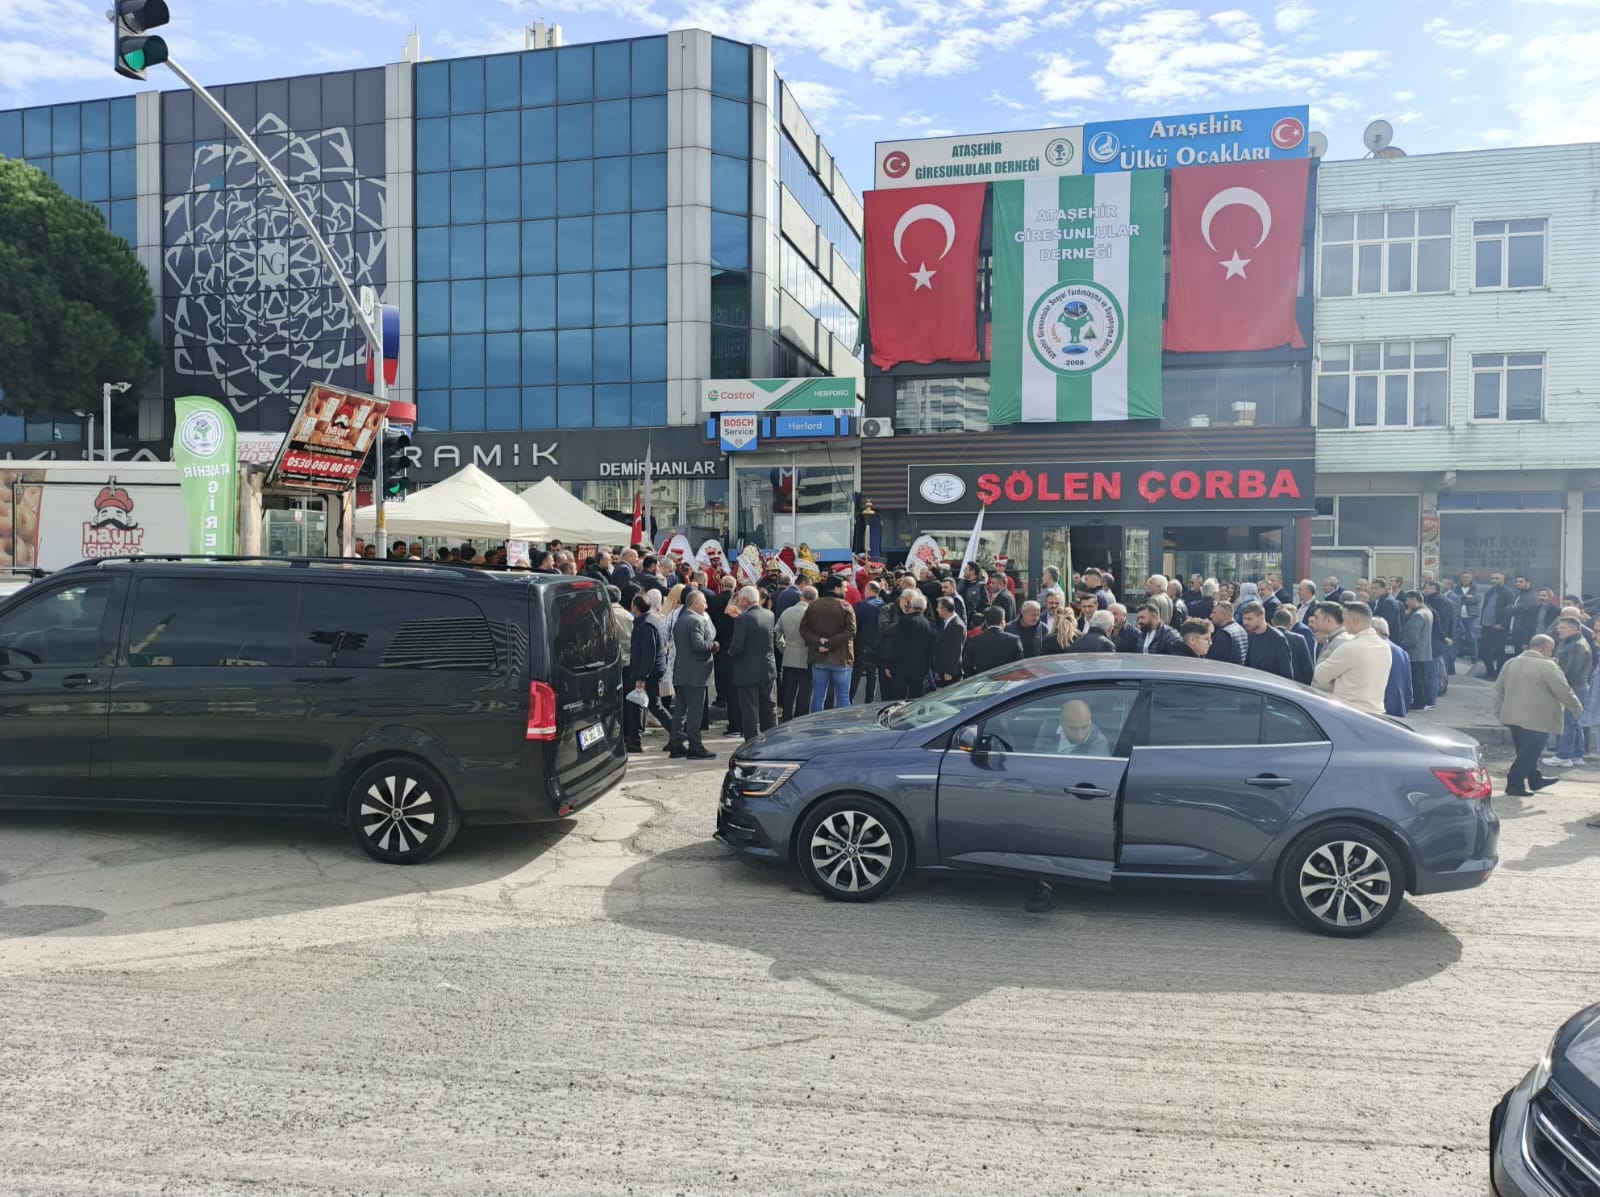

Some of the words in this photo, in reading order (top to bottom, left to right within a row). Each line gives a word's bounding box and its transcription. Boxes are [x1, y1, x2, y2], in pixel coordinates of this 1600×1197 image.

[951, 140, 1003, 159] ATAŞEHİR
[914, 162, 993, 181] GİRESUNLULAR
[994, 156, 1041, 175] DERNEĞİ
[1035, 203, 1119, 223] ATAŞEHİR
[1014, 222, 1141, 243] GİRESUNLULAR
[1039, 242, 1113, 262] DERNEĞİ
[720, 390, 756, 401] Castrol
[813, 388, 849, 398] HERFORD
[723, 418, 754, 428] BOSCH
[788, 421, 823, 431] Herford
[724, 428, 755, 437] Service
[287, 456, 312, 468] 0530
[312, 459, 330, 471] 060
[330, 461, 342, 473] 80
[342, 463, 355, 474] 60
[975, 469, 1121, 506] ŞÖLEN
[1137, 468, 1302, 505] ÇORBA
[82, 521, 145, 549] hayır
[82, 542, 145, 559] lokmas
